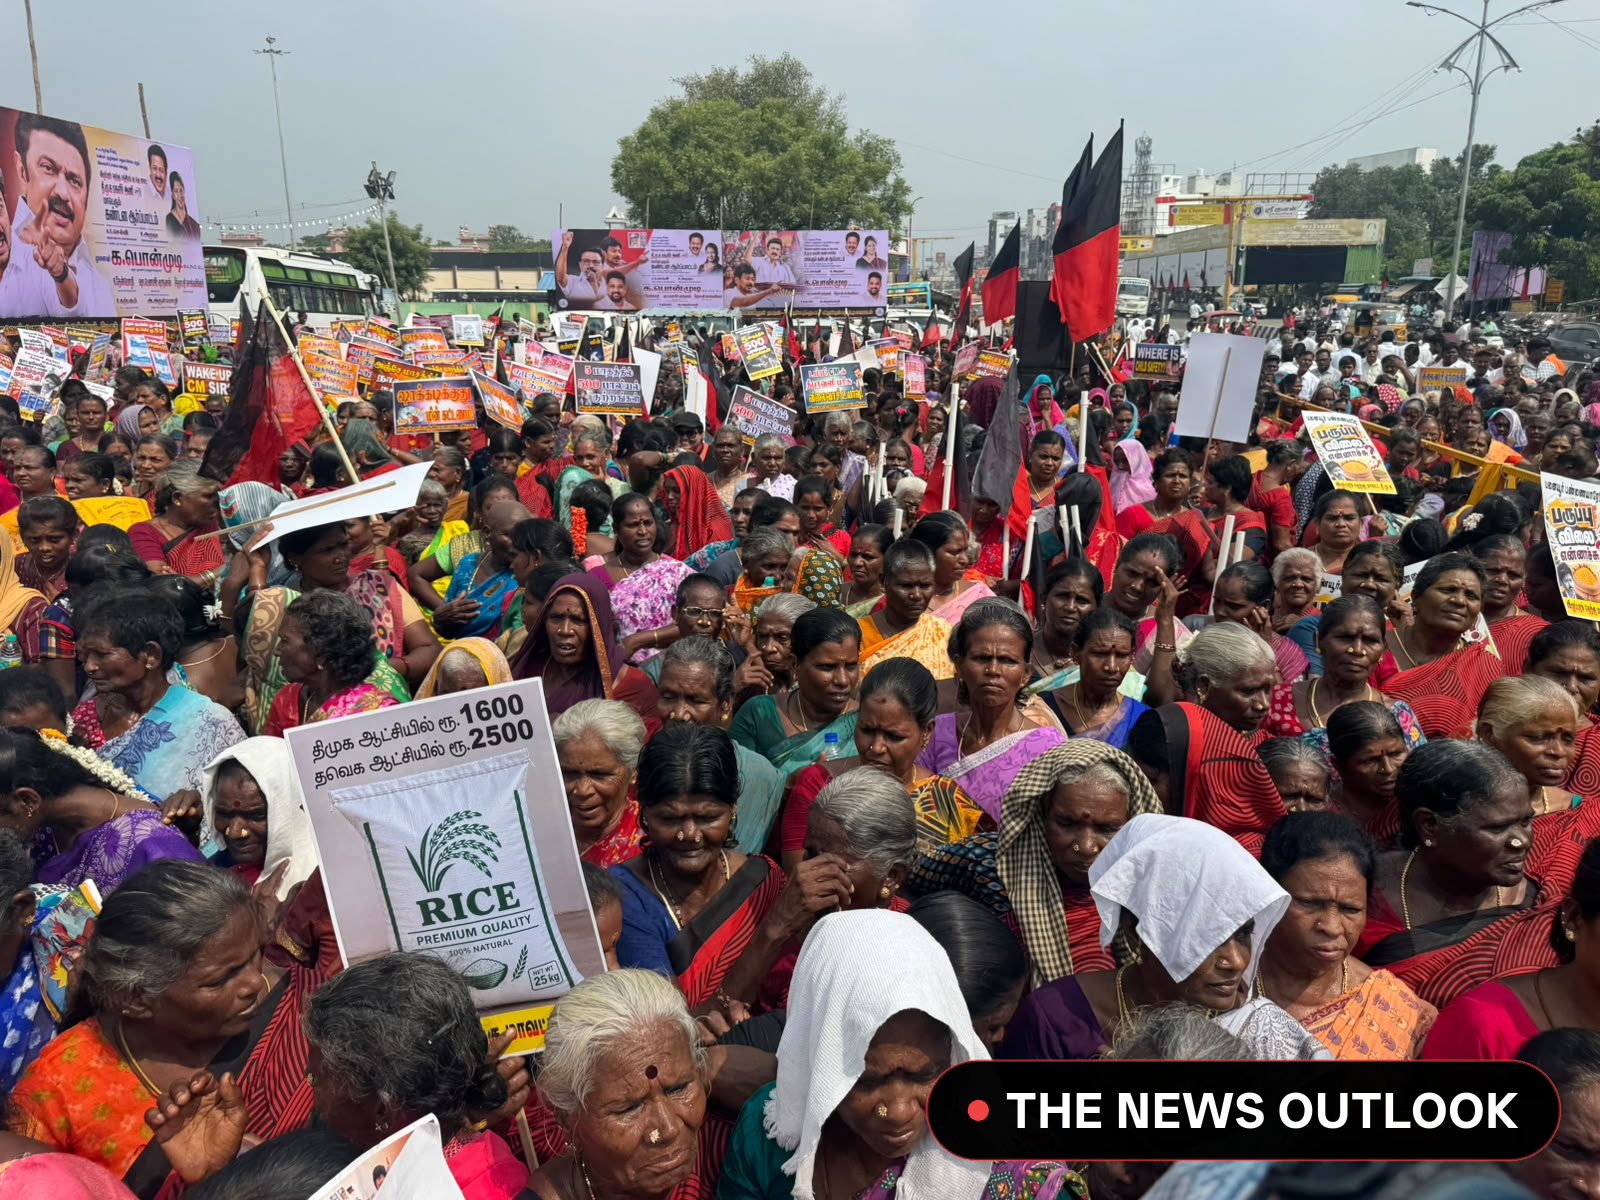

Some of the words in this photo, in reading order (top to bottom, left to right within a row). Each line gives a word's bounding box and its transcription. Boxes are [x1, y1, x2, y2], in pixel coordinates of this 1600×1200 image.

[111, 248, 183, 273] க.பொன்முடி
[184, 320, 203, 328] 500
[744, 338, 765, 350] 500
[1137, 347, 1168, 360] WHERE
[1170, 348, 1179, 361] IS
[186, 365, 216, 380] WAKE
[219, 369, 232, 382] UP
[585, 365, 592, 375] 5
[592, 365, 634, 378] மாதத்தில்
[187, 378, 206, 393] CM
[578, 378, 600, 389] 500
[602, 378, 640, 391] பாலியல்
[592, 390, 640, 404] குற்றங்கள்
[744, 393, 752, 403] 5
[751, 397, 789, 420] மாதத்தில்
[732, 403, 755, 419] 500
[755, 414, 792, 435] பாலியல்
[1316, 424, 1360, 440] பருப்பு
[1325, 439, 1363, 451] விலை
[1545, 480, 1564, 497] பனையூர்
[1551, 502, 1595, 527] பருப்பு
[1558, 526, 1595, 545] விலை
[312, 738, 354, 763] திமுக
[358, 716, 435, 748] ஆட்சியில்
[314, 761, 365, 789] தவெக
[369, 740, 444, 772] ஆட்சியில்
[416, 881, 520, 926] RICE
[416, 927, 477, 946] PREMIUM
[481, 914, 531, 935] QUALITY
[449, 947, 471, 957] 100%
[473, 939, 513, 953] NATURAL
[544, 965, 554, 973] WT
[534, 976, 548, 986] 25
[549, 972, 560, 983] kg
